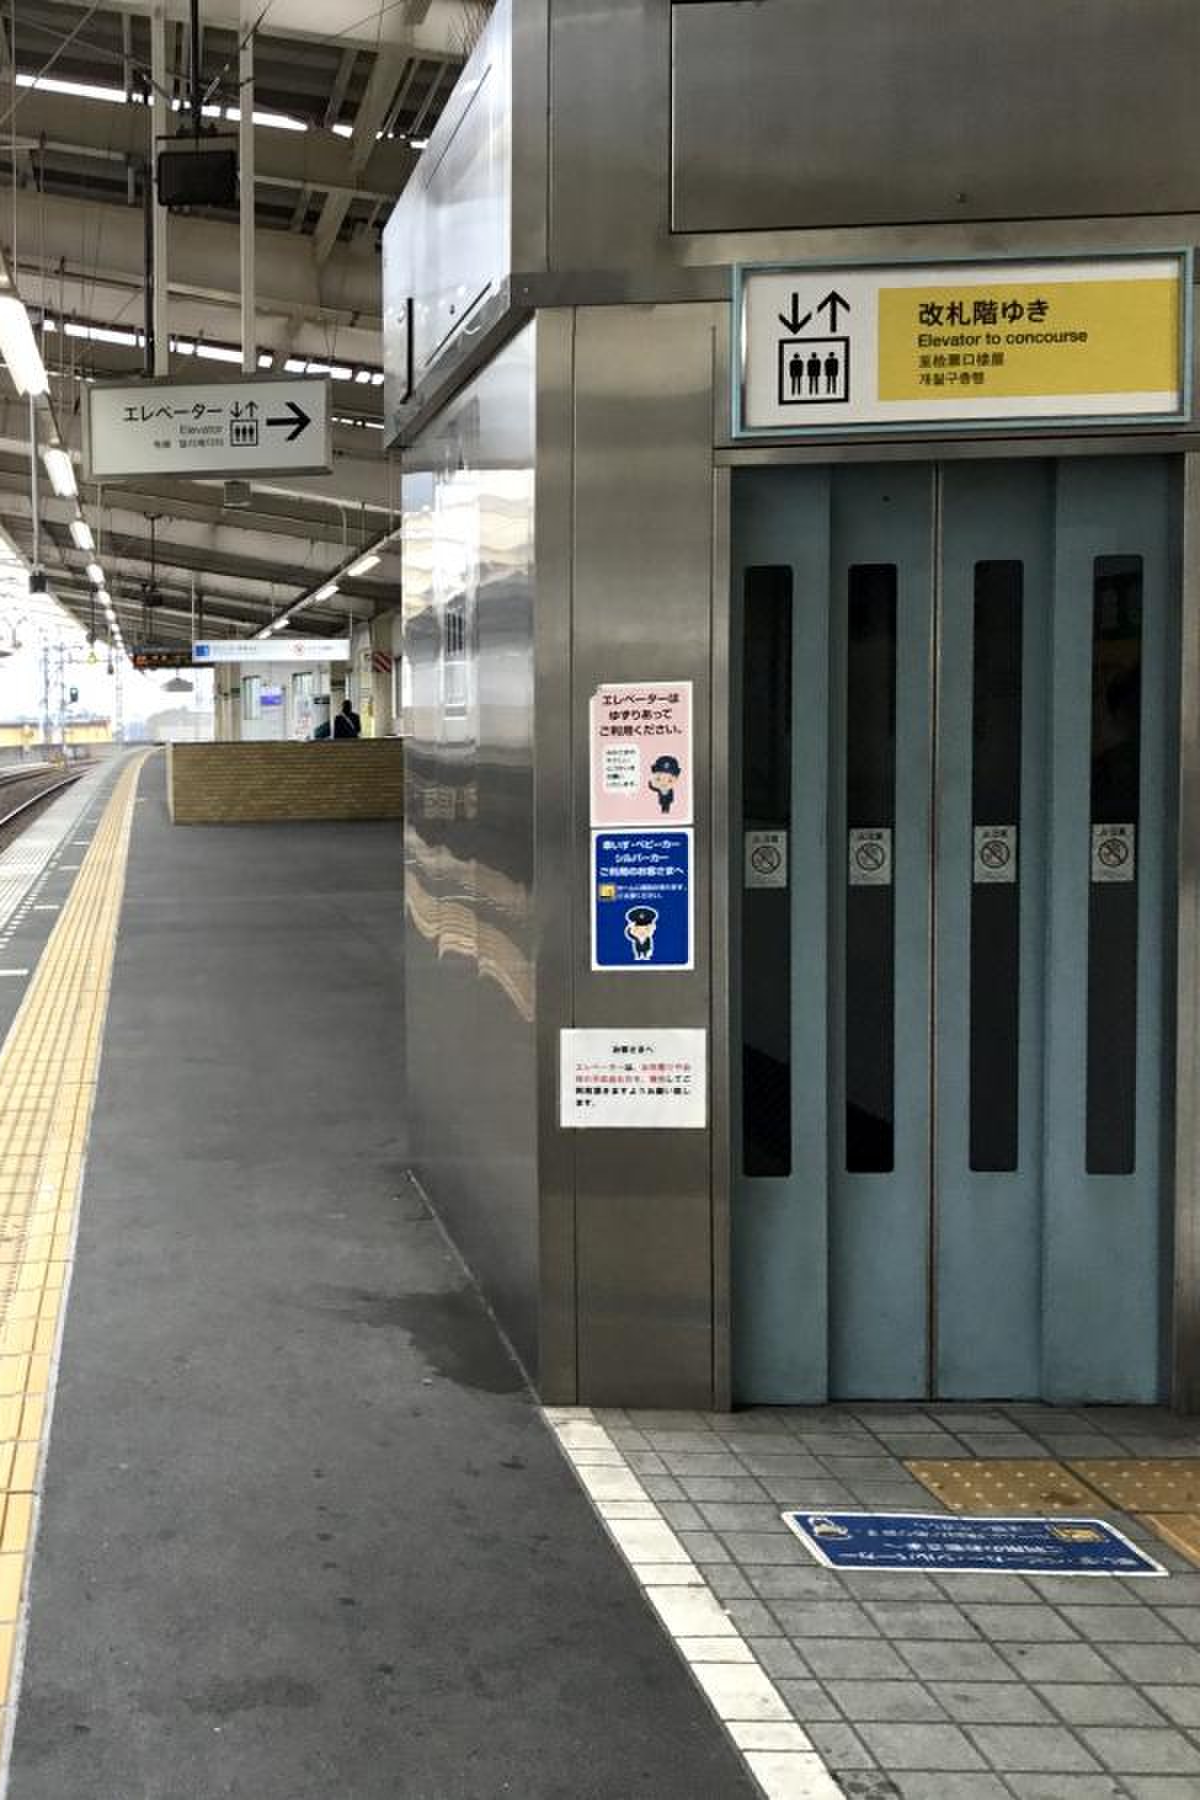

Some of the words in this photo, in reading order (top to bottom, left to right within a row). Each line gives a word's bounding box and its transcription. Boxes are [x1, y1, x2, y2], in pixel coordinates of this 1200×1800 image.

[918, 299, 1049, 327] 改札階ゆき
[918, 333, 982, 347] Elevator
[986, 332, 1001, 345] to
[1006, 331, 1088, 345] concourse
[122, 403, 223, 422] エレベーター
[602, 693, 681, 705] エレベーターは
[609, 708, 673, 720] ゆずりあって
[599, 724, 683, 736] ご利用ください。
